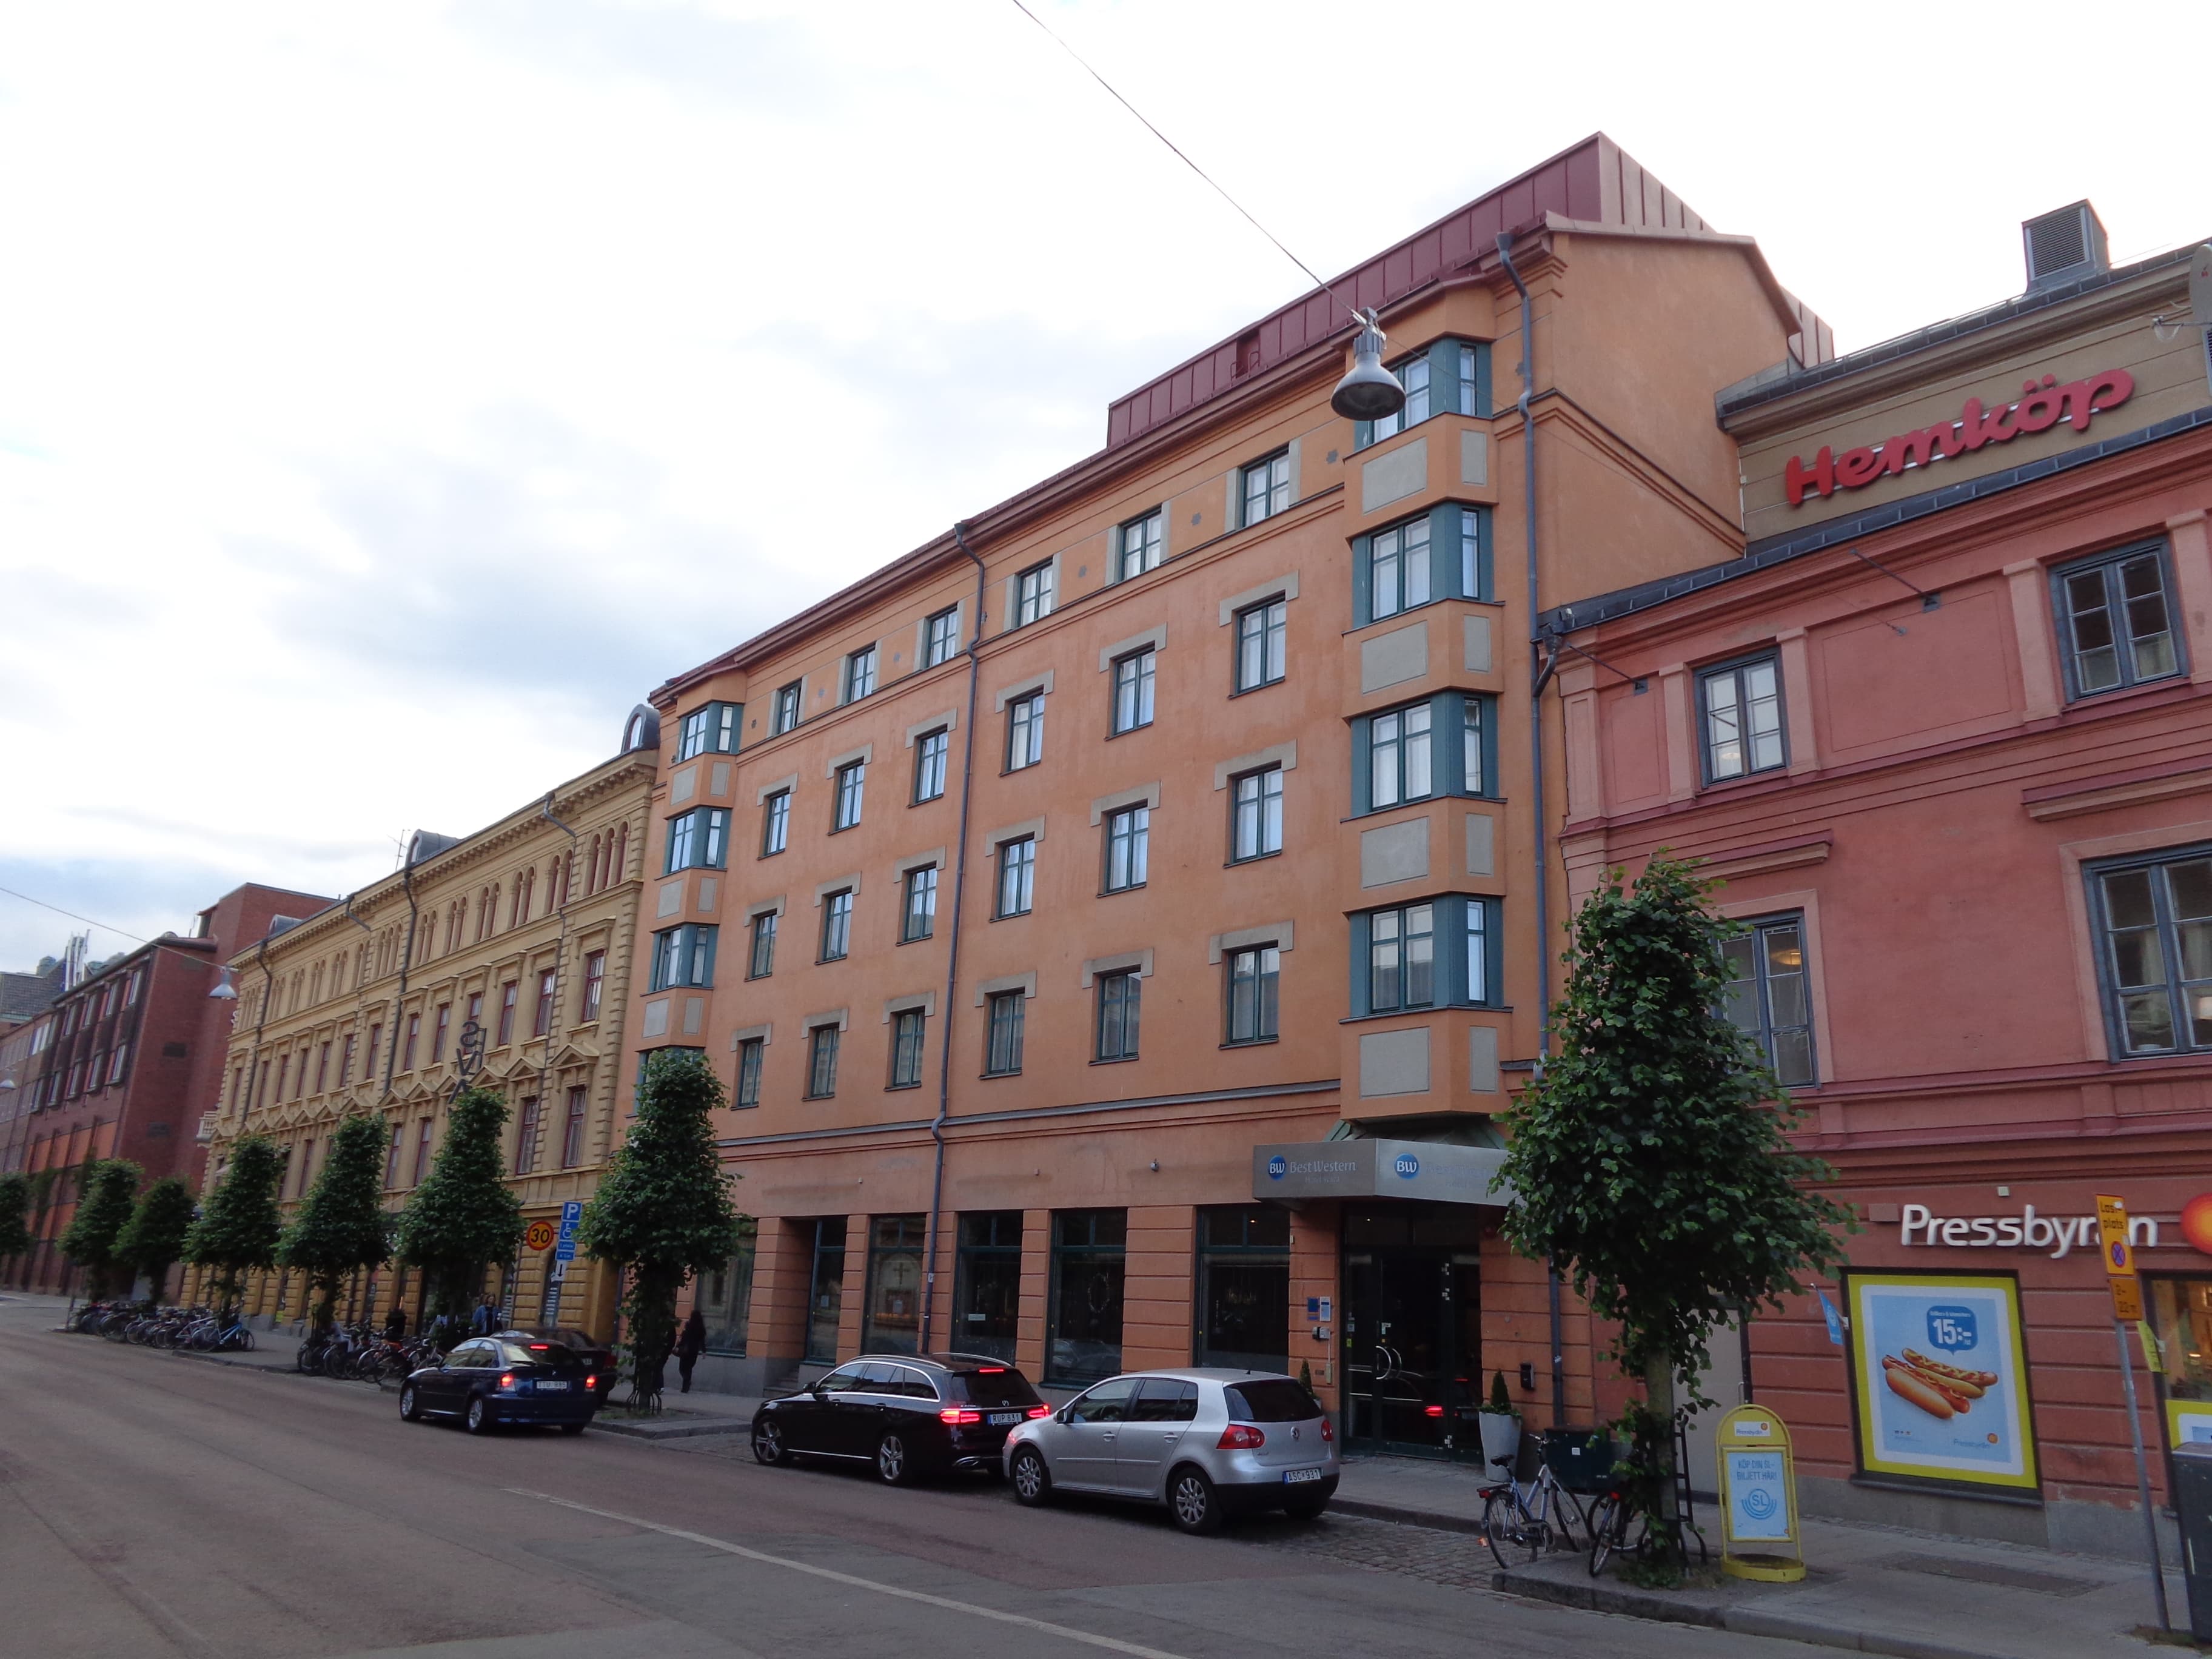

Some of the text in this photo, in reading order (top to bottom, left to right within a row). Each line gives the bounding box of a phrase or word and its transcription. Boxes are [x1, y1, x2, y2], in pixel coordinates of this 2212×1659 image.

[1785, 368, 2134, 504] Hemköp
[1270, 1163, 1285, 1174] BW
[1396, 1161, 1417, 1173] BW
[566, 1203, 578, 1219] P
[531, 1228, 550, 1244] 30
[1901, 1204, 2158, 1259] Pressbyrn
[1932, 1318, 1972, 1344] 15:-
[1289, 1470, 1319, 1481] ASC 931
[1751, 1494, 1768, 1507] SL
